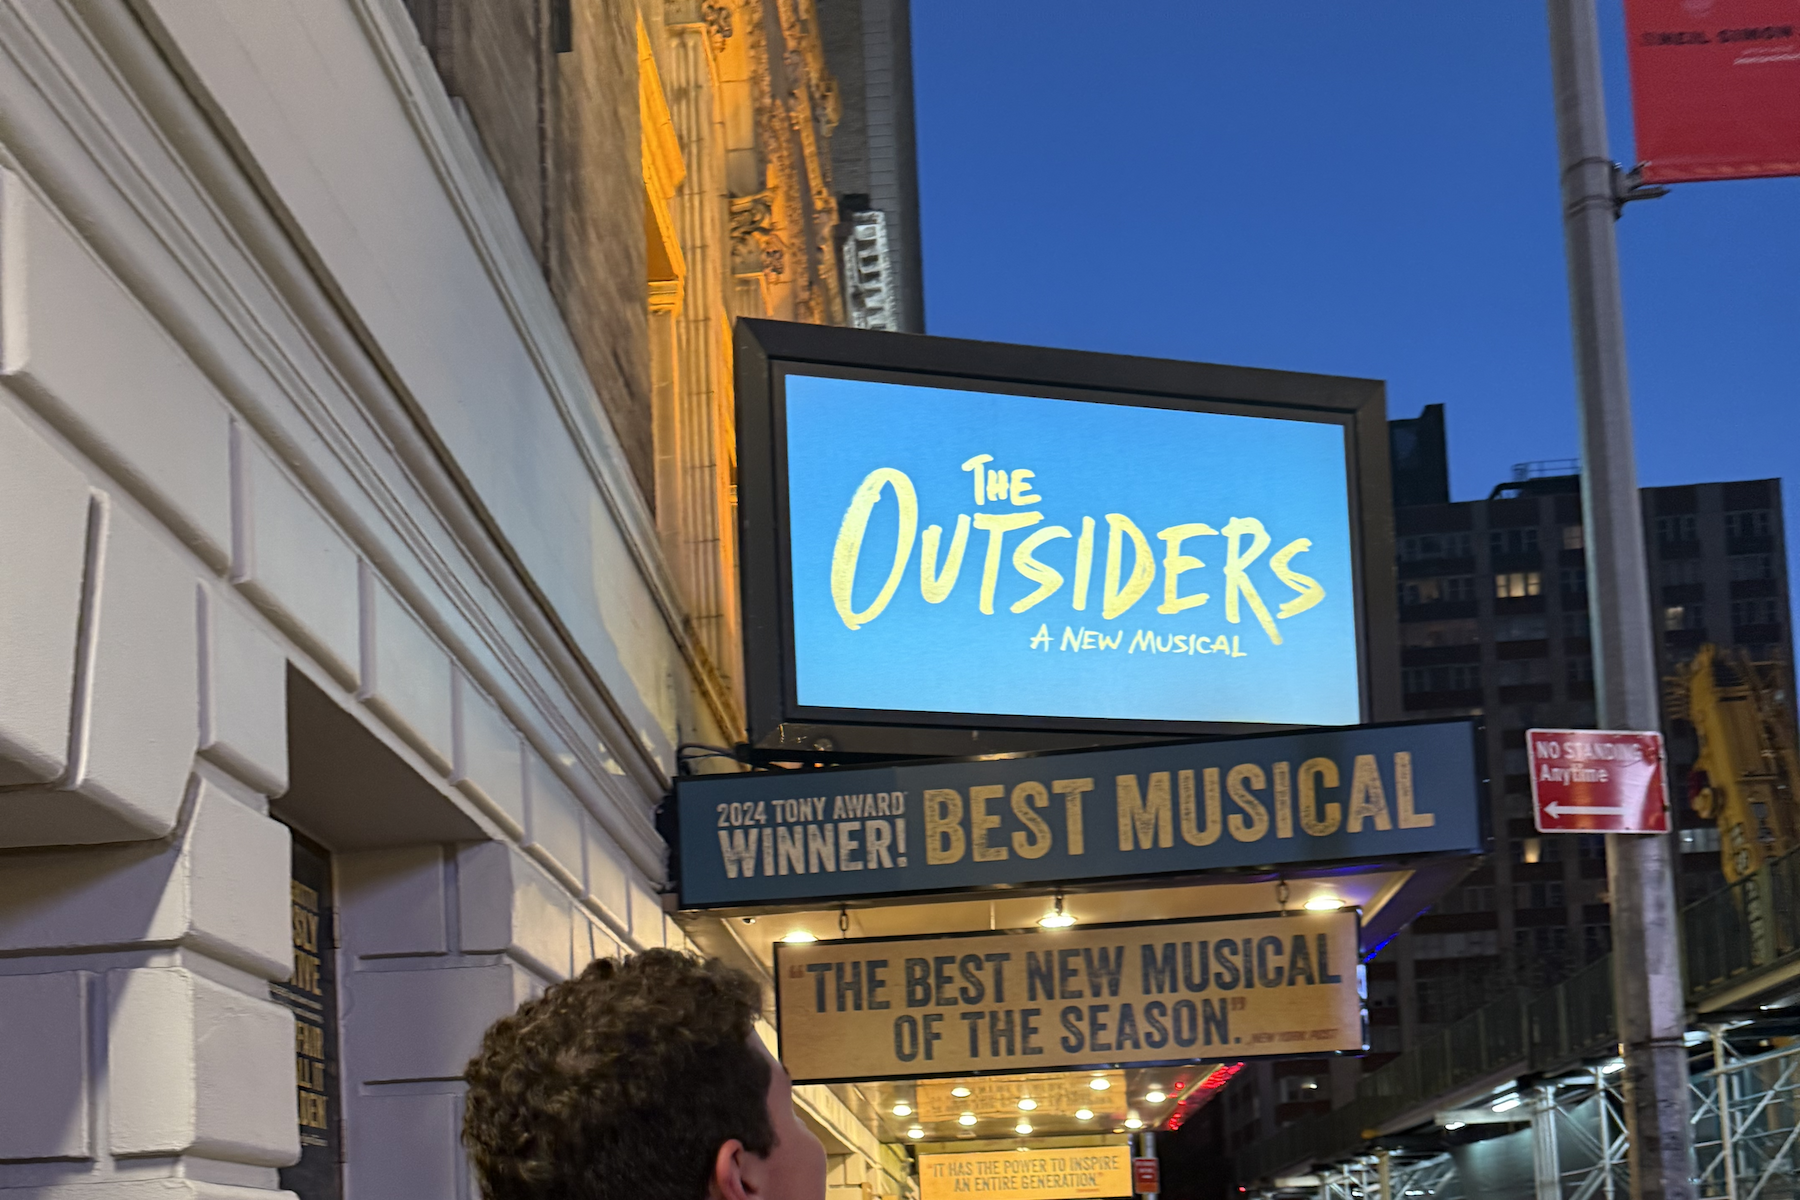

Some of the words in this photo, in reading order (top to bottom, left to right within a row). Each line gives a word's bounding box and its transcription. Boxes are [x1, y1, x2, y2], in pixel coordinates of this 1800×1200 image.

[961, 454, 1042, 505] THE
[830, 467, 1326, 645] OUTSIDERS
[1030, 623, 1054, 652] A
[1060, 625, 1123, 652] NEW
[1128, 629, 1247, 657] MUSICAL
[1536, 741, 1560, 758] NO
[1541, 763, 1609, 786] Anytime
[716, 801, 767, 827] 2024
[771, 797, 826, 823] TONY
[833, 792, 906, 820] AWARD
[923, 777, 1095, 865] BEST
[1115, 751, 1435, 851] MUSICAL
[718, 818, 908, 878] WINNER!
[905, 952, 1011, 1008] BEST
[1026, 946, 1124, 1002] NEW
[1141, 933, 1342, 995] MUSICAL
[894, 1013, 943, 1062] OF
[960, 1008, 1043, 1058] THE
[949, 1161, 973, 1176] HAS
[977, 1160, 1000, 1175] THE
[1003, 1158, 1047, 1174] POWER
[1050, 1158, 1065, 1172] TO
[1069, 1155, 1120, 1171] INSPIRE
[954, 1177, 970, 1192] AN
[974, 1175, 1019, 1191] ENTIRE
